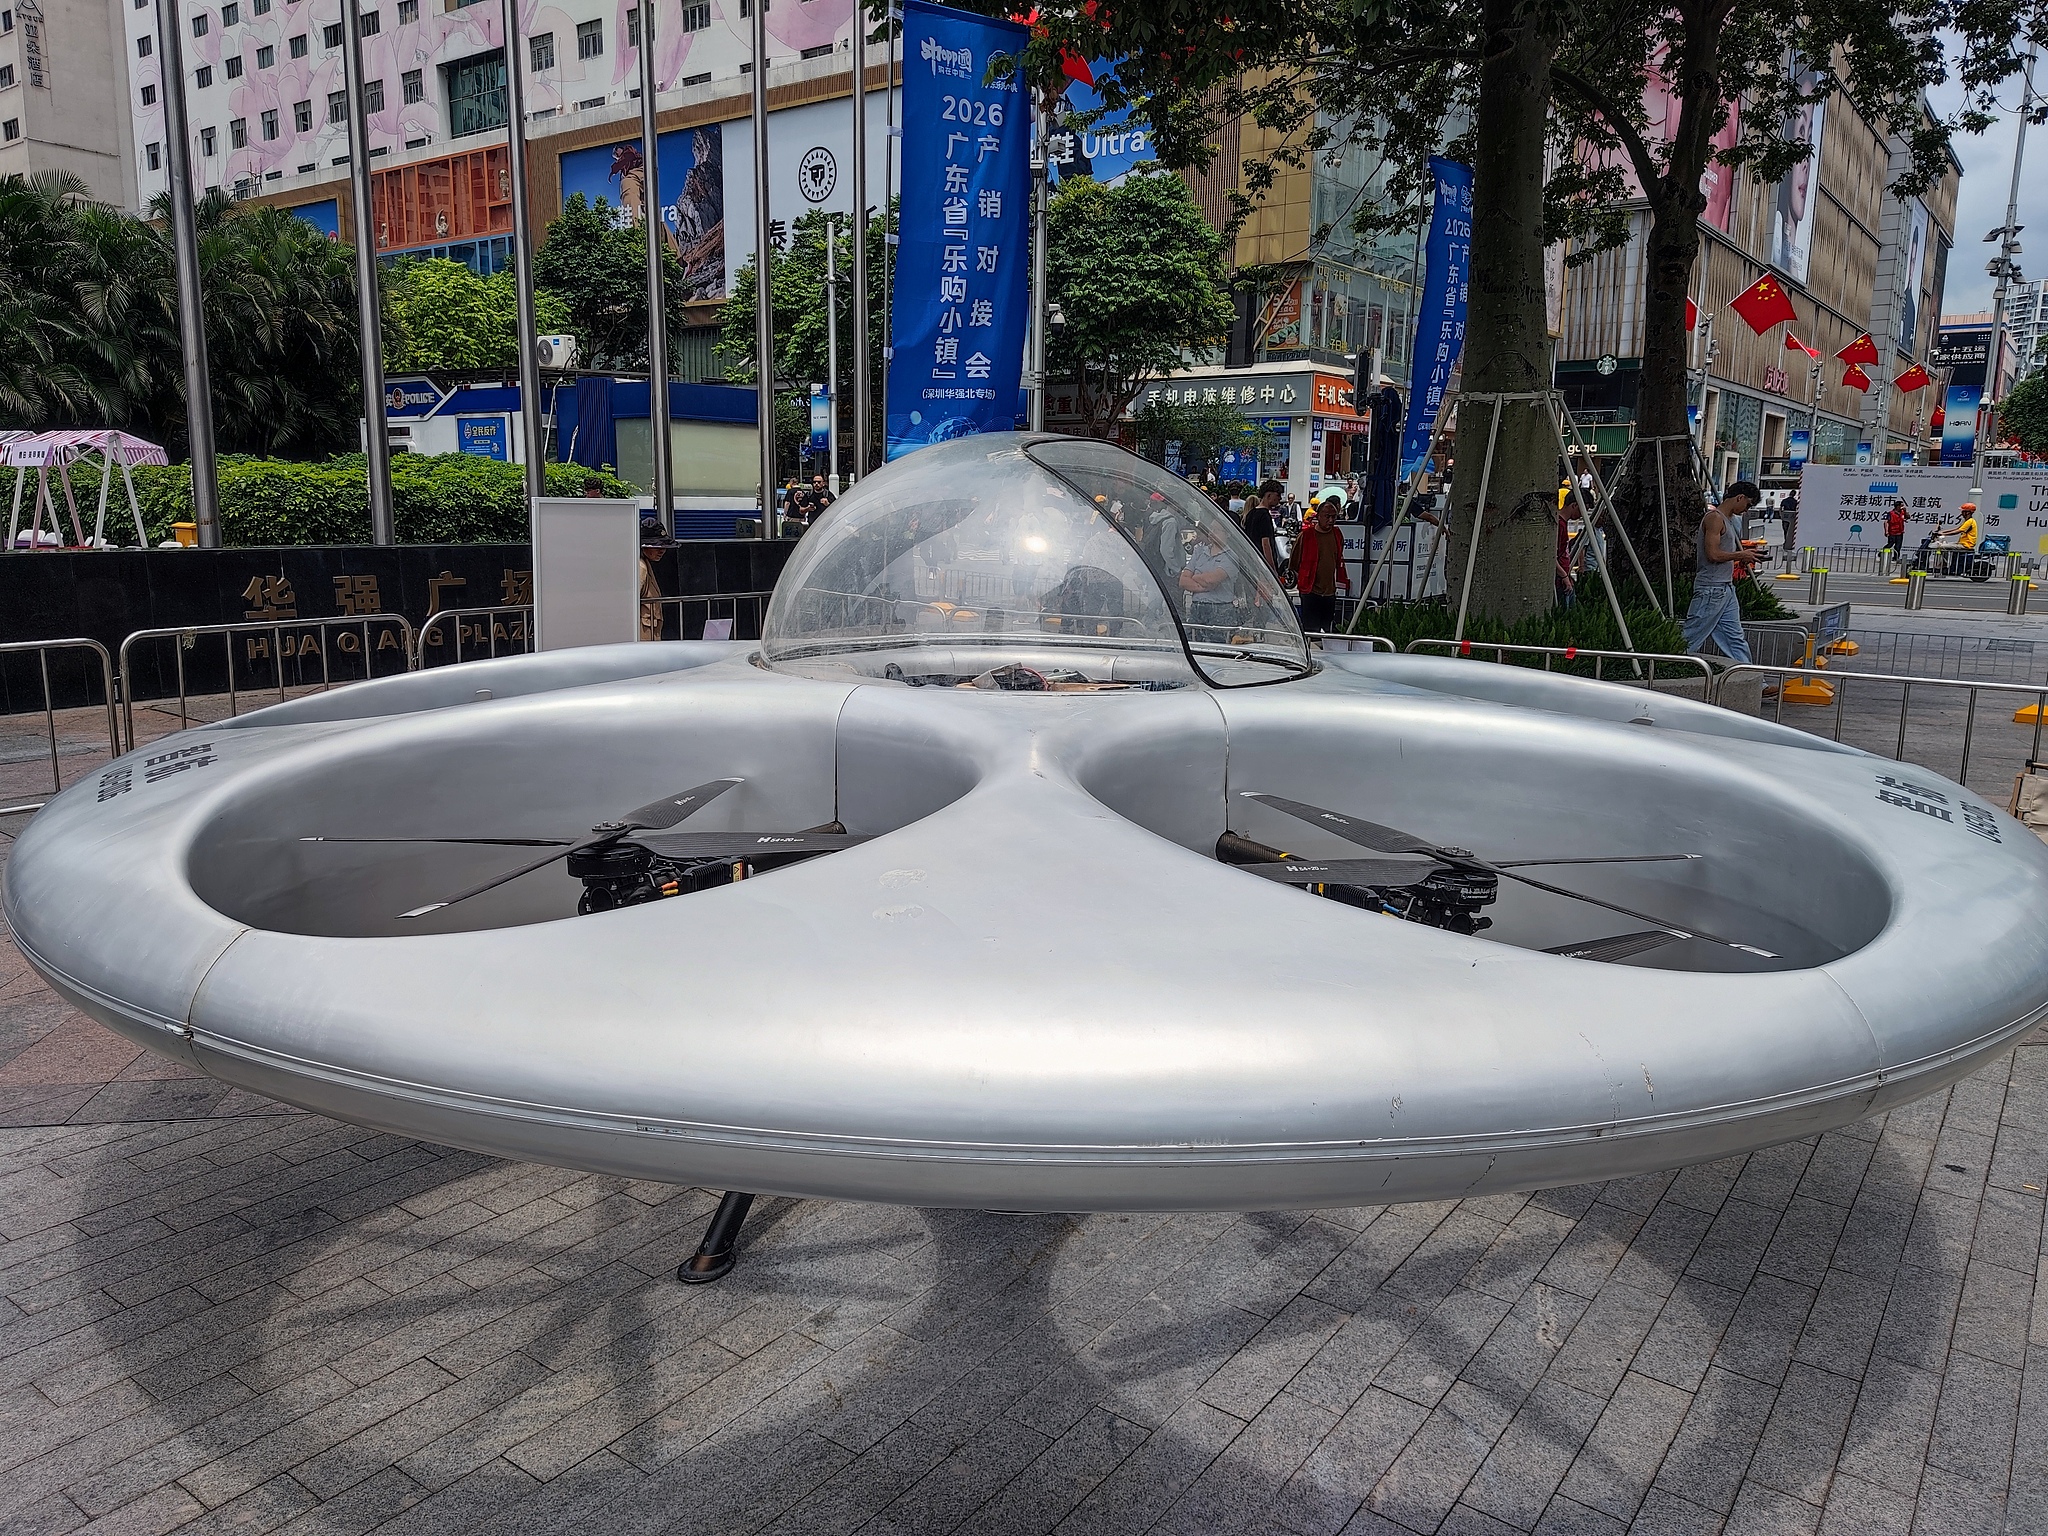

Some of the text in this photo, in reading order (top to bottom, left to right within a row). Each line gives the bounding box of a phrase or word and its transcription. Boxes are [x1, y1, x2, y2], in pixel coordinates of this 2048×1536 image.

[942, 95, 1004, 126] 2026
[1082, 130, 1145, 159] Ultra
[1445, 218, 1471, 239] 2026
[932, 131, 969, 379] 广东省『乐购小镇』
[965, 135, 1002, 379] 产销对接会
[405, 392, 435, 405] POLICE
[922, 388, 997, 400] (深圳华强北专场)
[1147, 383, 1297, 408] 手机电脑维修中心
[241, 569, 533, 620] 华强广场
[247, 634, 321, 658] HUA
[460, 619, 534, 644] PLAZ
